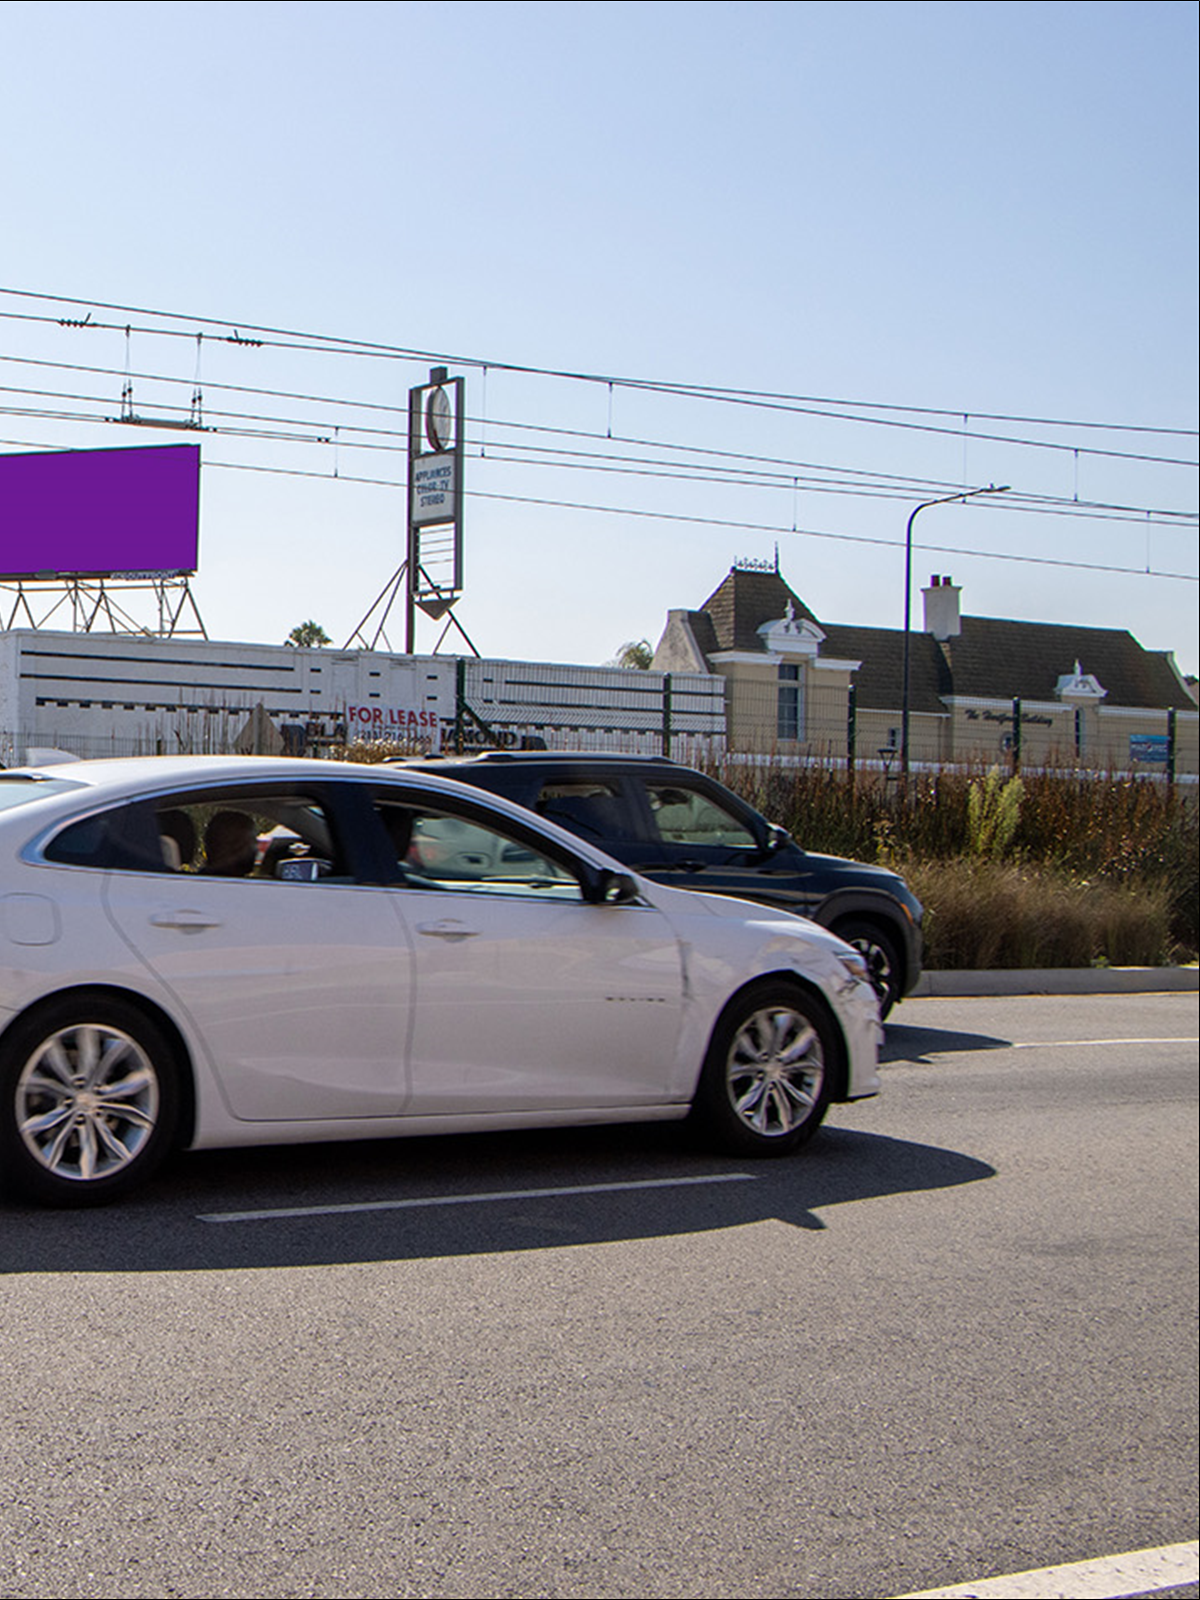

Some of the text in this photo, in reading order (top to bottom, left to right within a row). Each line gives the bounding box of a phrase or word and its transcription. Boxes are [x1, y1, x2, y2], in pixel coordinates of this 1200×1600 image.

[420, 493, 444, 507] STEREO
[348, 706, 437, 727] FOR LEASE
